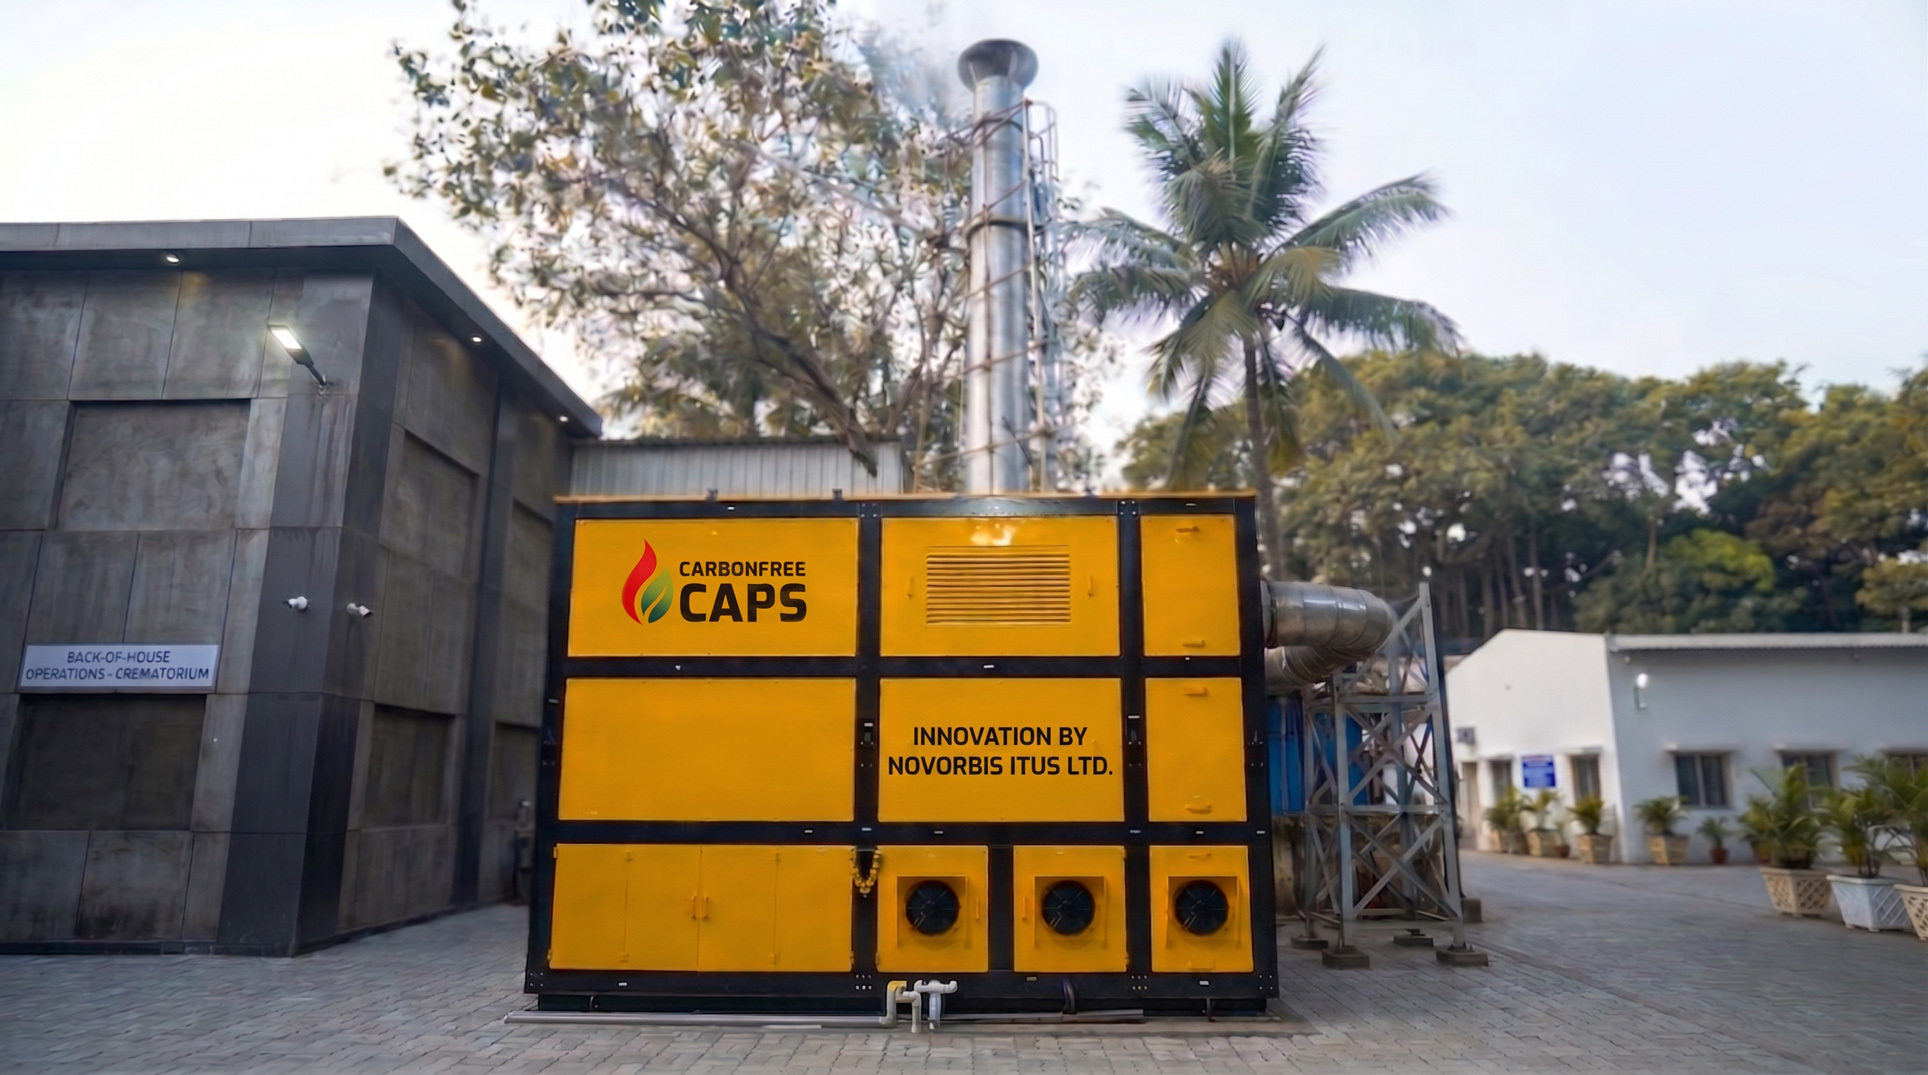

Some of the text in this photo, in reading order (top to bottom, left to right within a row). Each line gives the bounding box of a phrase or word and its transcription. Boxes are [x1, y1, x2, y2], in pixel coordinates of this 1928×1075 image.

[679, 561, 806, 577] CARBONFREE
[679, 583, 807, 622] CAPS
[67, 651, 171, 663] BACK-OF-HOUSE
[26, 668, 105, 680] OPERATIONS
[115, 667, 209, 680] CREMATORIUM
[913, 727, 1088, 745] INNOVATION BY
[888, 756, 1113, 775] NOVORBIS ITUS LTD.
